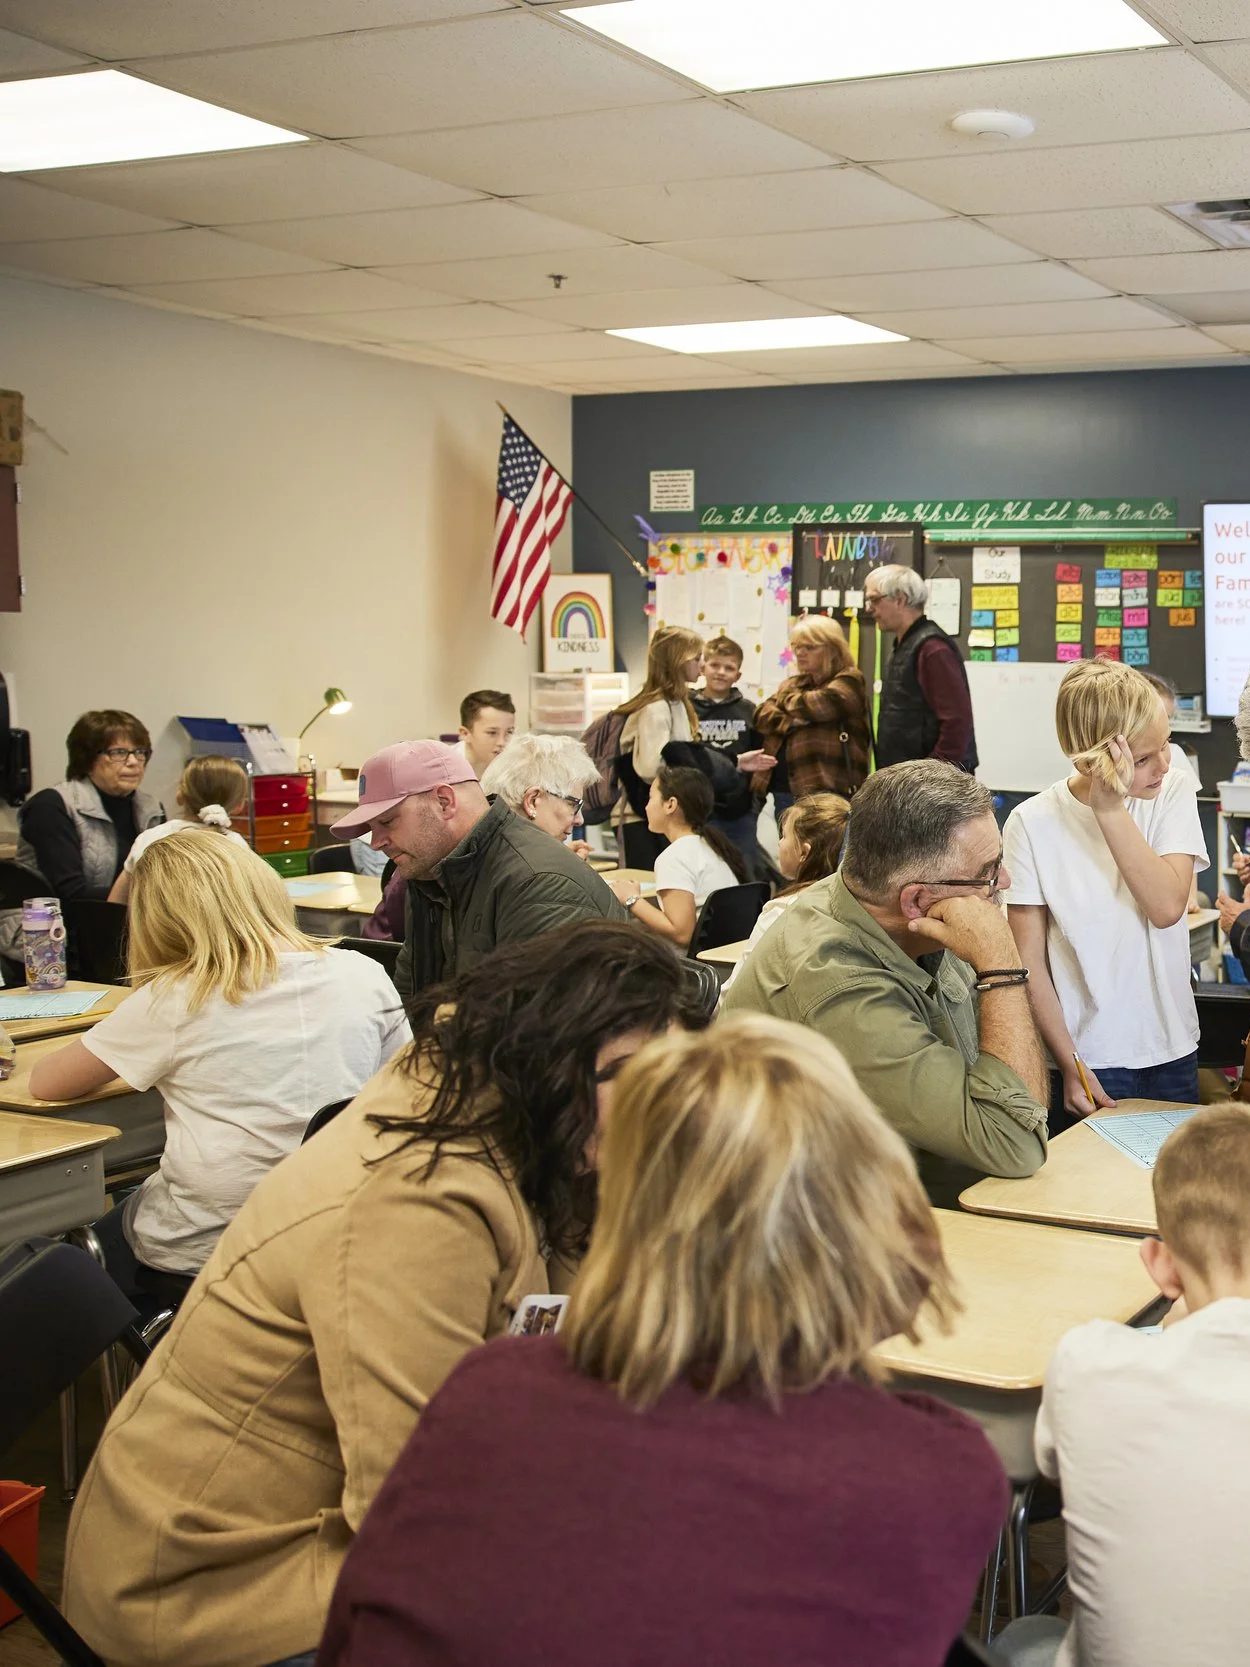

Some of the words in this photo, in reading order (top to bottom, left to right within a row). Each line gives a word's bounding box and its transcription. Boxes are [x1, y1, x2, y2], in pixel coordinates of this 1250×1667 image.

[701, 506, 725, 524] Aa
[730, 506, 759, 524] Bb
[763, 505, 784, 524] Cc
[788, 505, 816, 523] Dd
[820, 504, 842, 523] Ee
[912, 503, 943, 521] Hh
[972, 503, 999, 529] Jj
[1001, 501, 1032, 521] Kk
[1034, 501, 1071, 521] Ll
[1076, 502, 1112, 520] Mm
[1115, 502, 1145, 520] Nn
[1149, 502, 1174, 520] Oo
[1215, 552, 1246, 564] our
[984, 569, 1011, 581] Study
[1214, 601, 1233, 609] are
[557, 640, 601, 653] KINDNESS
